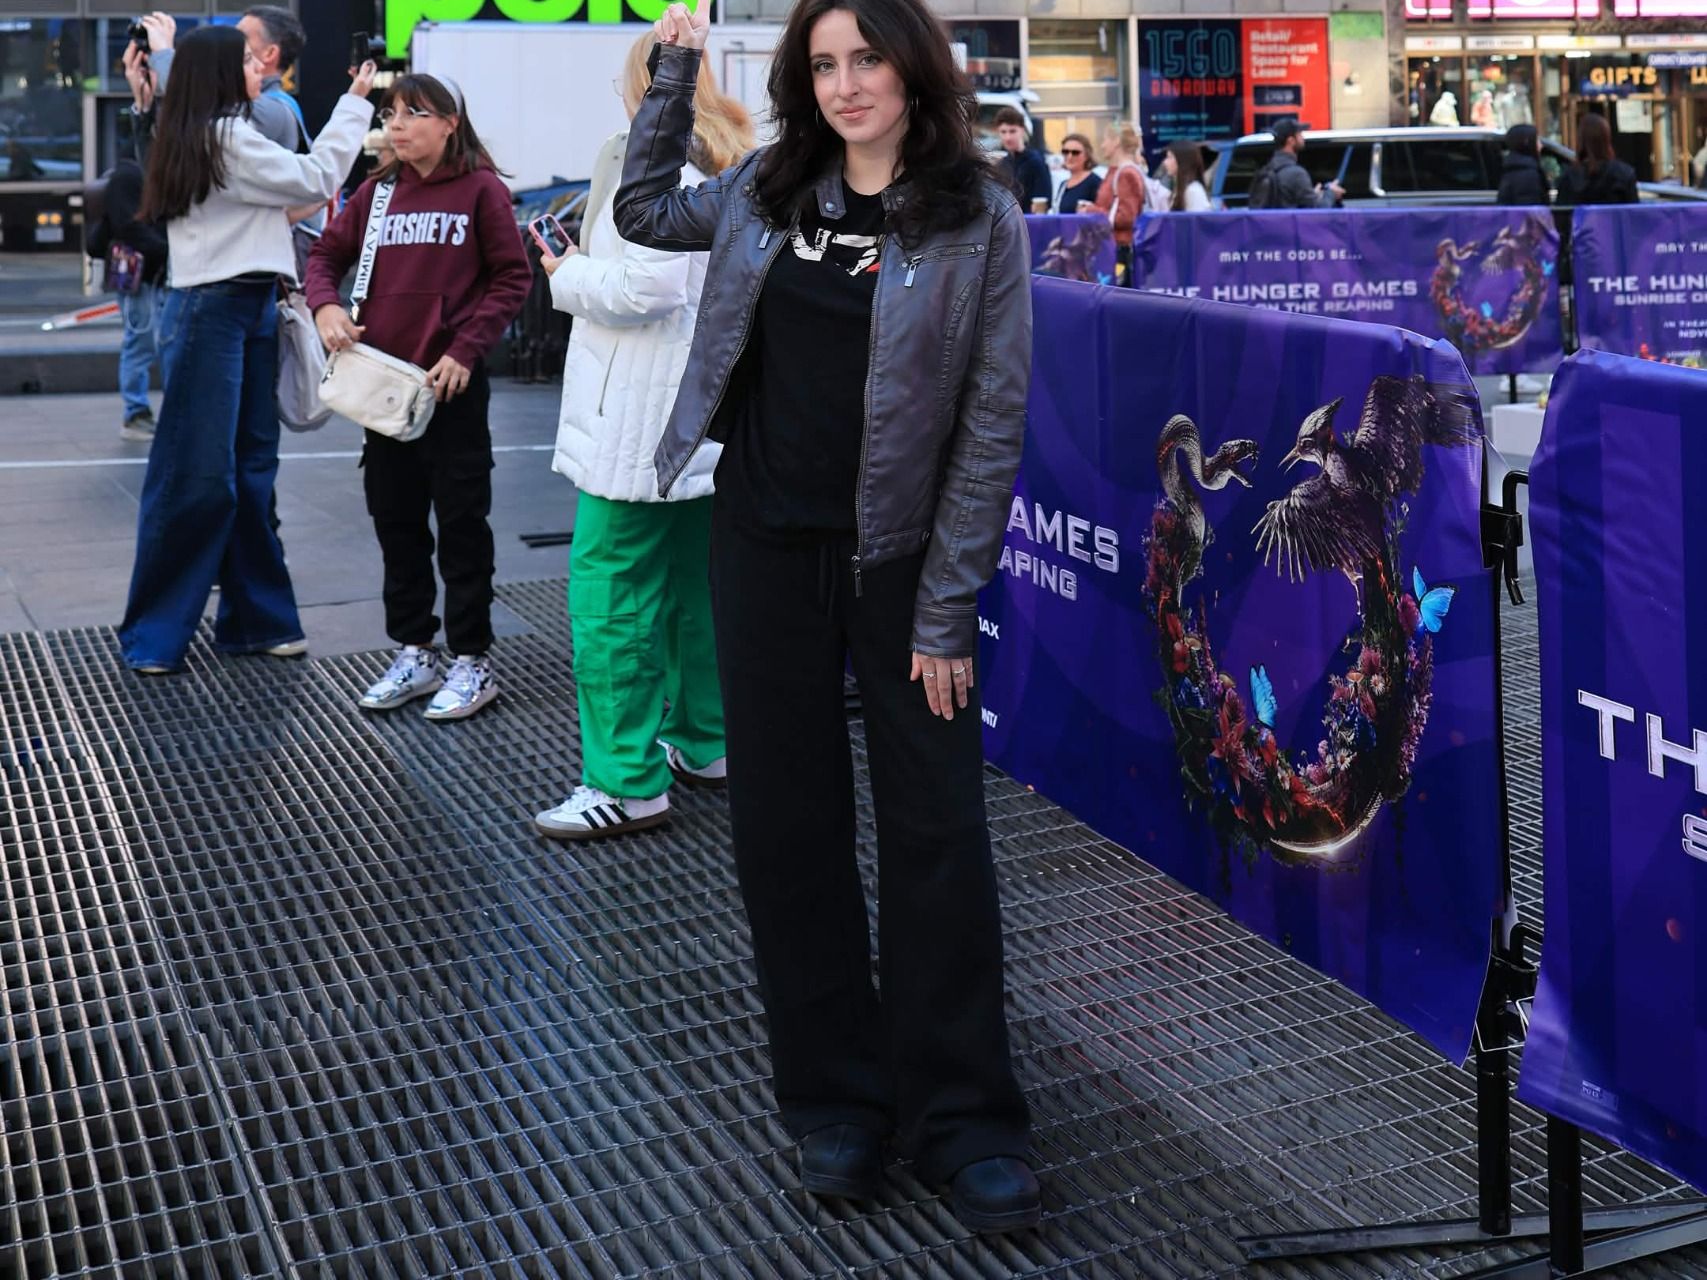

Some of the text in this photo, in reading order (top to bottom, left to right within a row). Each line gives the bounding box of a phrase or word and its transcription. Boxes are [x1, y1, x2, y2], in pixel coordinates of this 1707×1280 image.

[1145, 29, 1236, 78] 1560
[1590, 65, 1657, 86] GIFTS
[1151, 78, 1236, 97] BROADWAY
[1219, 251, 1250, 263] MAY
[1255, 250, 1282, 262] THE
[1287, 249, 1325, 261] ODDS
[1655, 242, 1685, 254] MAY
[1213, 283, 1321, 301] HUNGER
[1331, 280, 1418, 298] GAMES
[1588, 274, 1707, 292] THE HUN
[1284, 301, 1319, 313] THE
[1323, 299, 1395, 312] REAPING
[1613, 292, 1687, 306] SUNRISE
[997, 545, 1077, 601] APING
